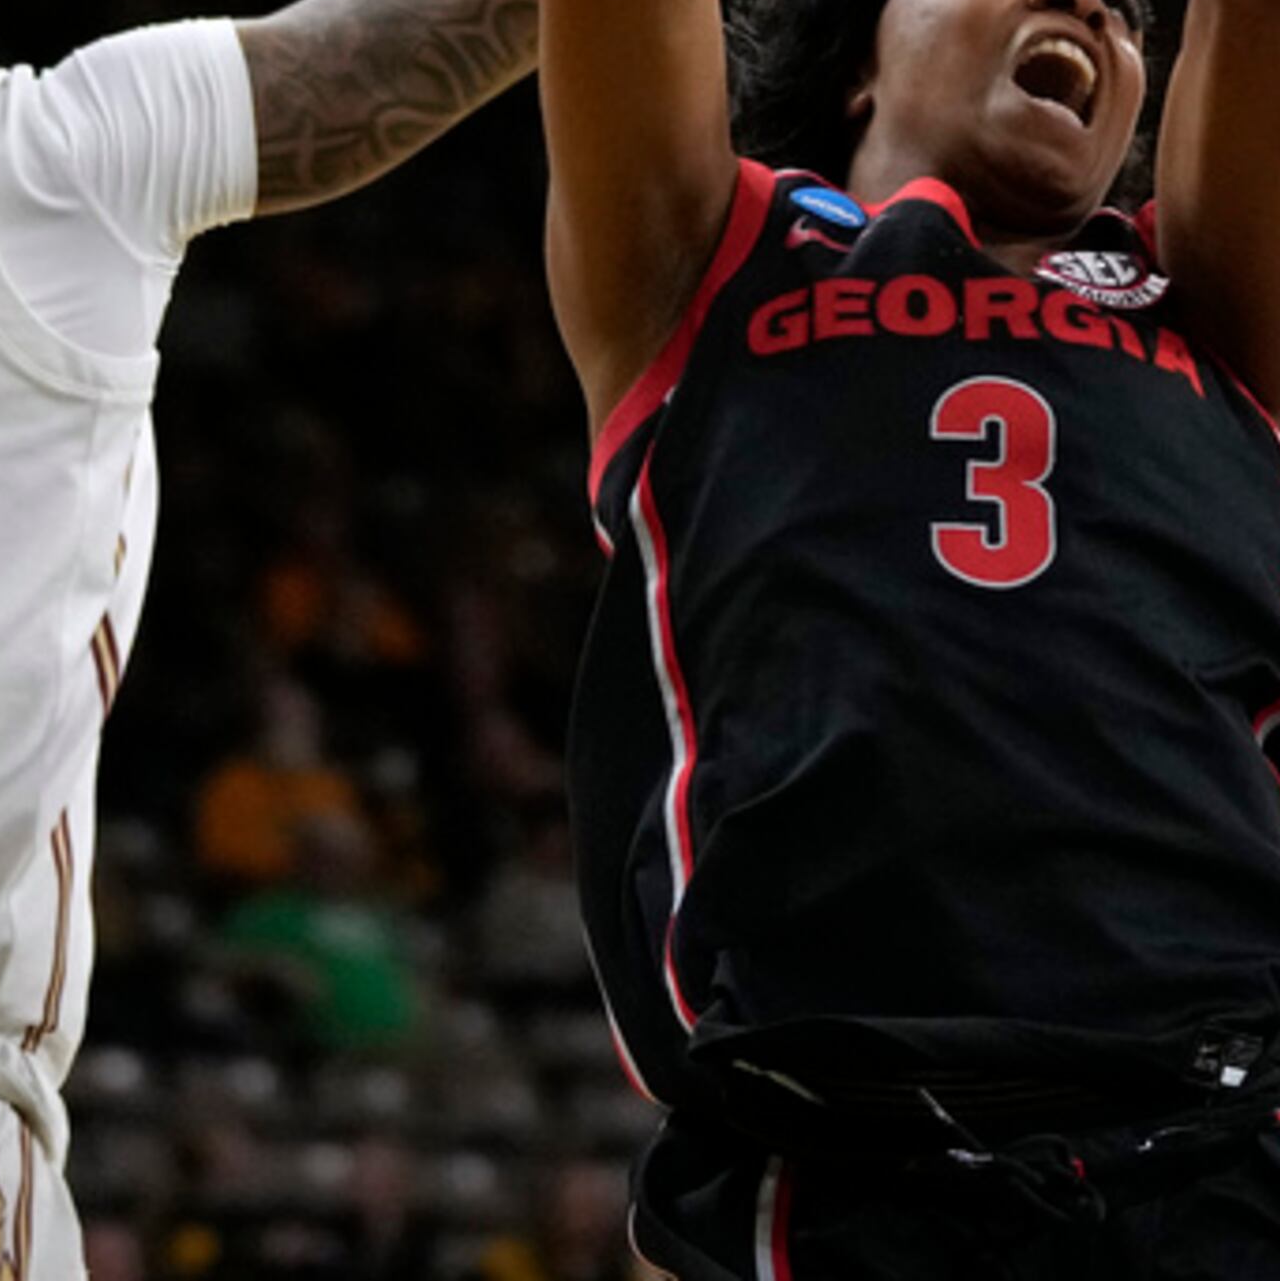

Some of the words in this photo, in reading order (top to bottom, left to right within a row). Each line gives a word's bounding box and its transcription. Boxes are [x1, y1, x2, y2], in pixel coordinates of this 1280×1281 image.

[1047, 251, 1139, 287] SEC
[747, 274, 1205, 397] GEORGIA
[930, 375, 1056, 589] 3
